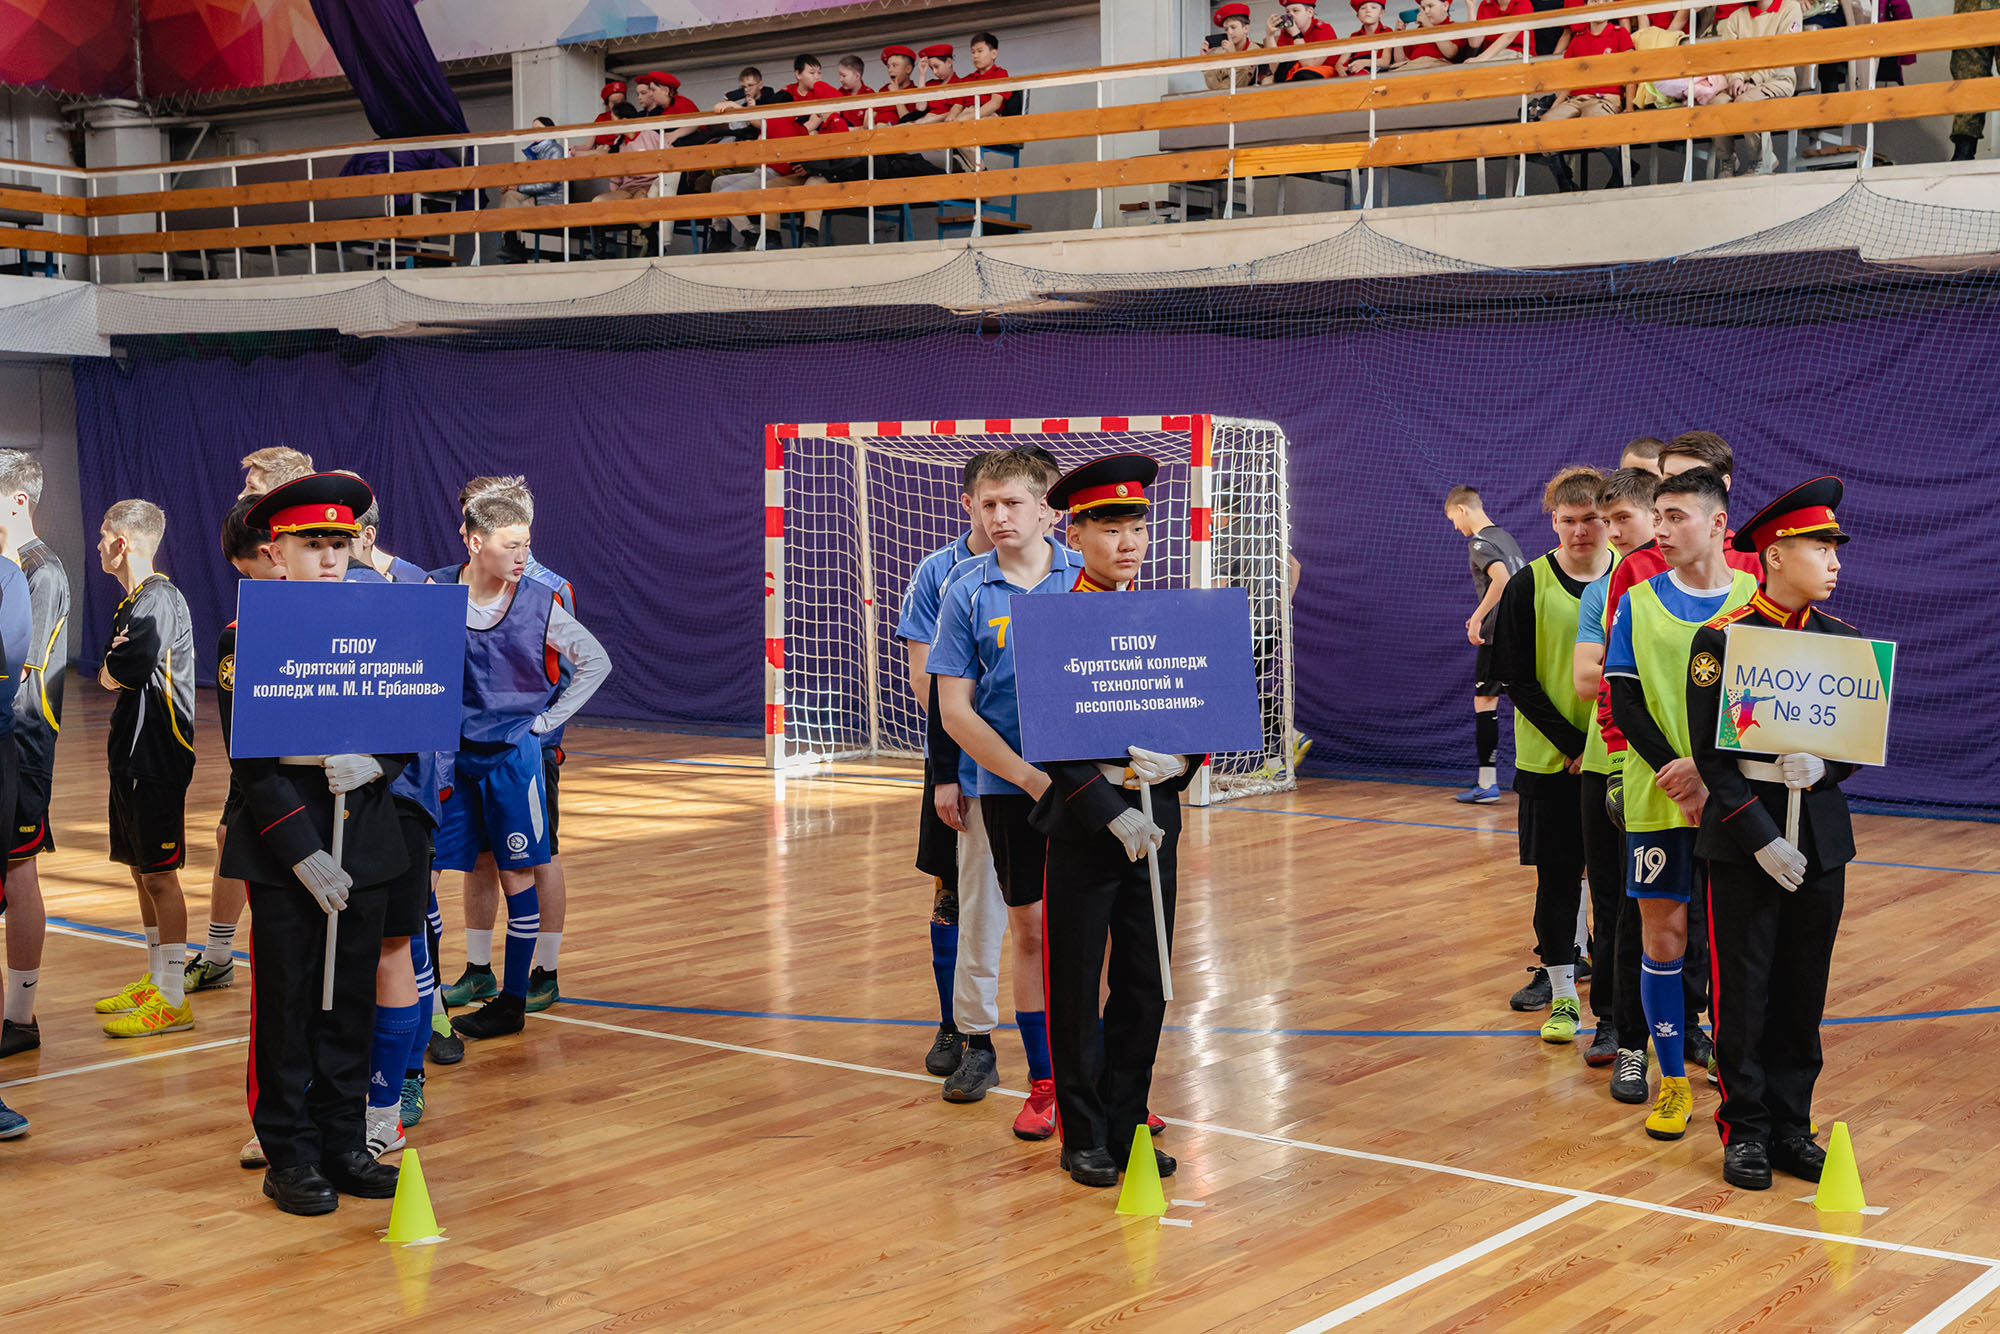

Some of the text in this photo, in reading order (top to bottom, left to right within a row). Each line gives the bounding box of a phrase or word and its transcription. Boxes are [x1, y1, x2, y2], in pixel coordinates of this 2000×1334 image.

[988, 616, 1010, 648] 7
[331, 638, 377, 654] ГБПОУ
[1110, 635, 1157, 651] ГБПОУ
[279, 659, 424, 678] «Бурятский аграрный
[1063, 655, 1208, 676] «Бурятский колледж
[253, 680, 445, 700] колледж им. М. Н. Ербанова»
[1092, 675, 1184, 693] технологий и
[1735, 664, 1812, 692] МАОУ
[1818, 674, 1880, 701] СОШ
[1075, 695, 1205, 714] лесопользования»
[1773, 699, 1837, 727] № 35
[1633, 845, 1667, 884] 19
